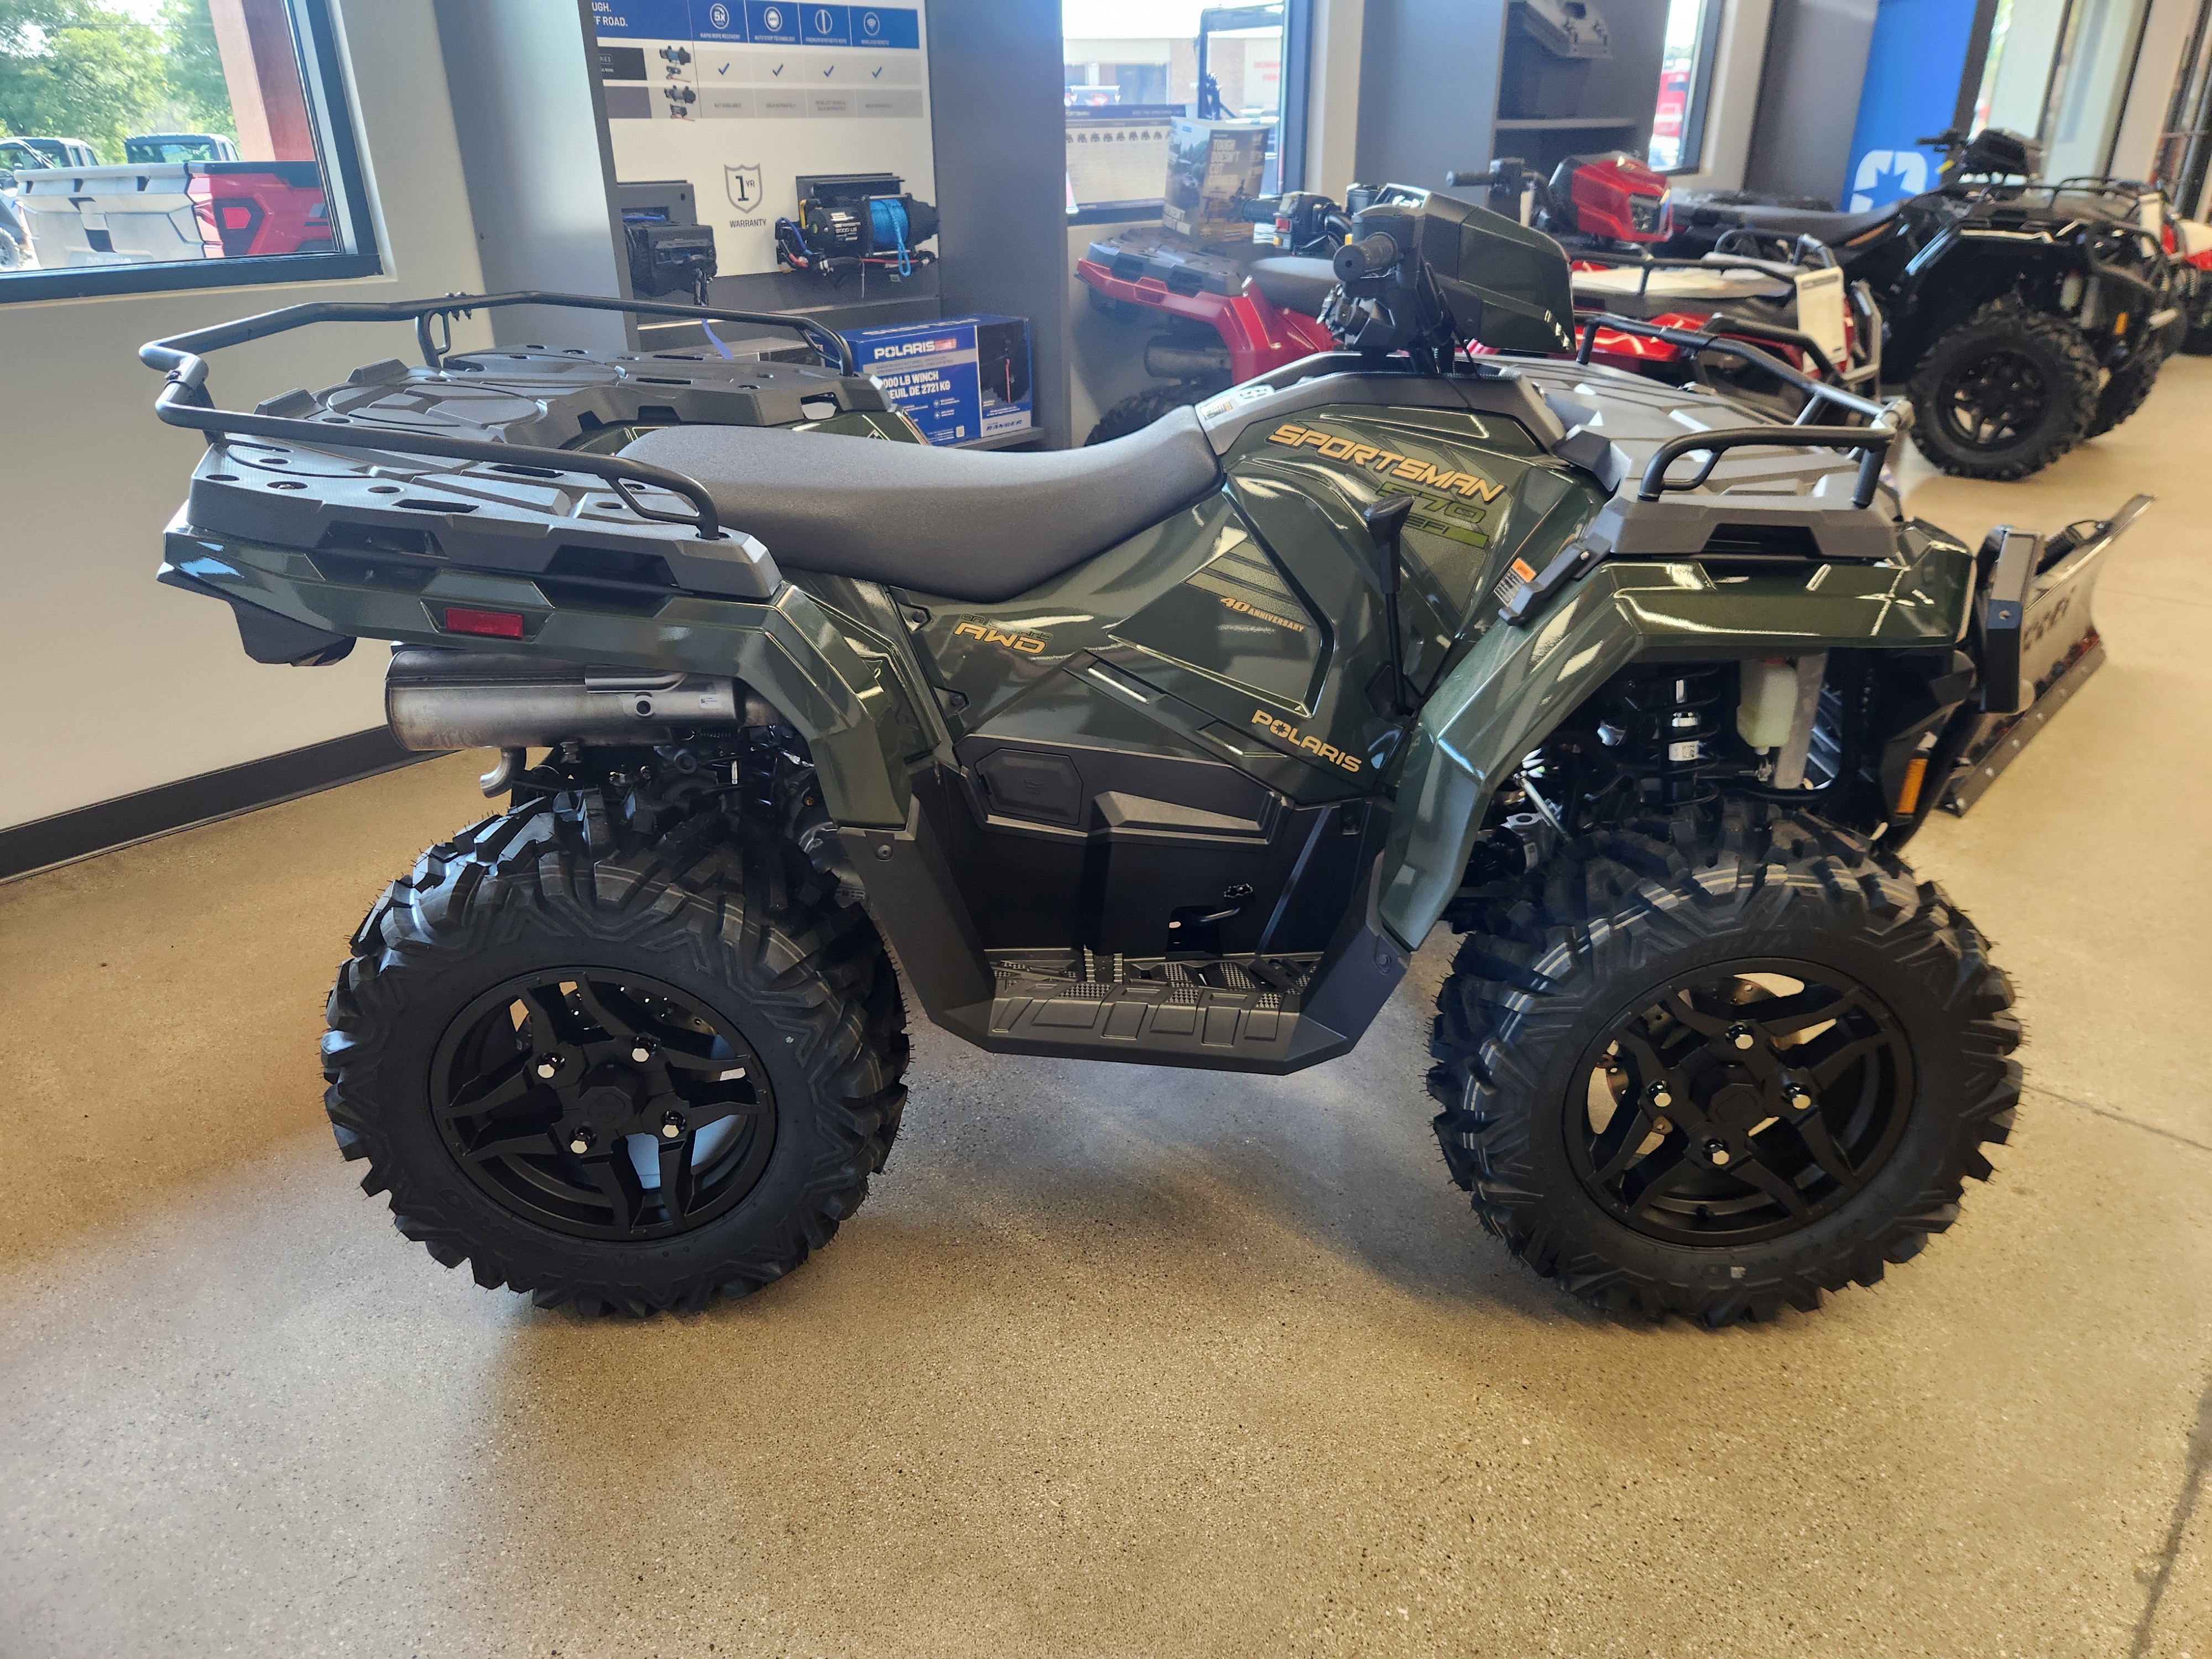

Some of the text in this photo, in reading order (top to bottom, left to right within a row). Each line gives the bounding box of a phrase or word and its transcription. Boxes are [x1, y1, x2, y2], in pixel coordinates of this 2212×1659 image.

[603, 17, 628, 27] ROAD.
[735, 175, 749, 201] 1
[729, 218, 766, 228] WARRANTY
[874, 341, 935, 359] POLARIS
[899, 375, 911, 386] LB
[911, 371, 938, 384] WINCH
[888, 380, 951, 399] EUIL DE 2721 KG
[987, 420, 1022, 431] RANGER
[1268, 424, 1506, 503] SPORTSMAN
[1219, 597, 1304, 632] 40 ANNIVERSARY
[953, 622, 1047, 654] AWD
[1251, 709, 1362, 773] POLARIS
